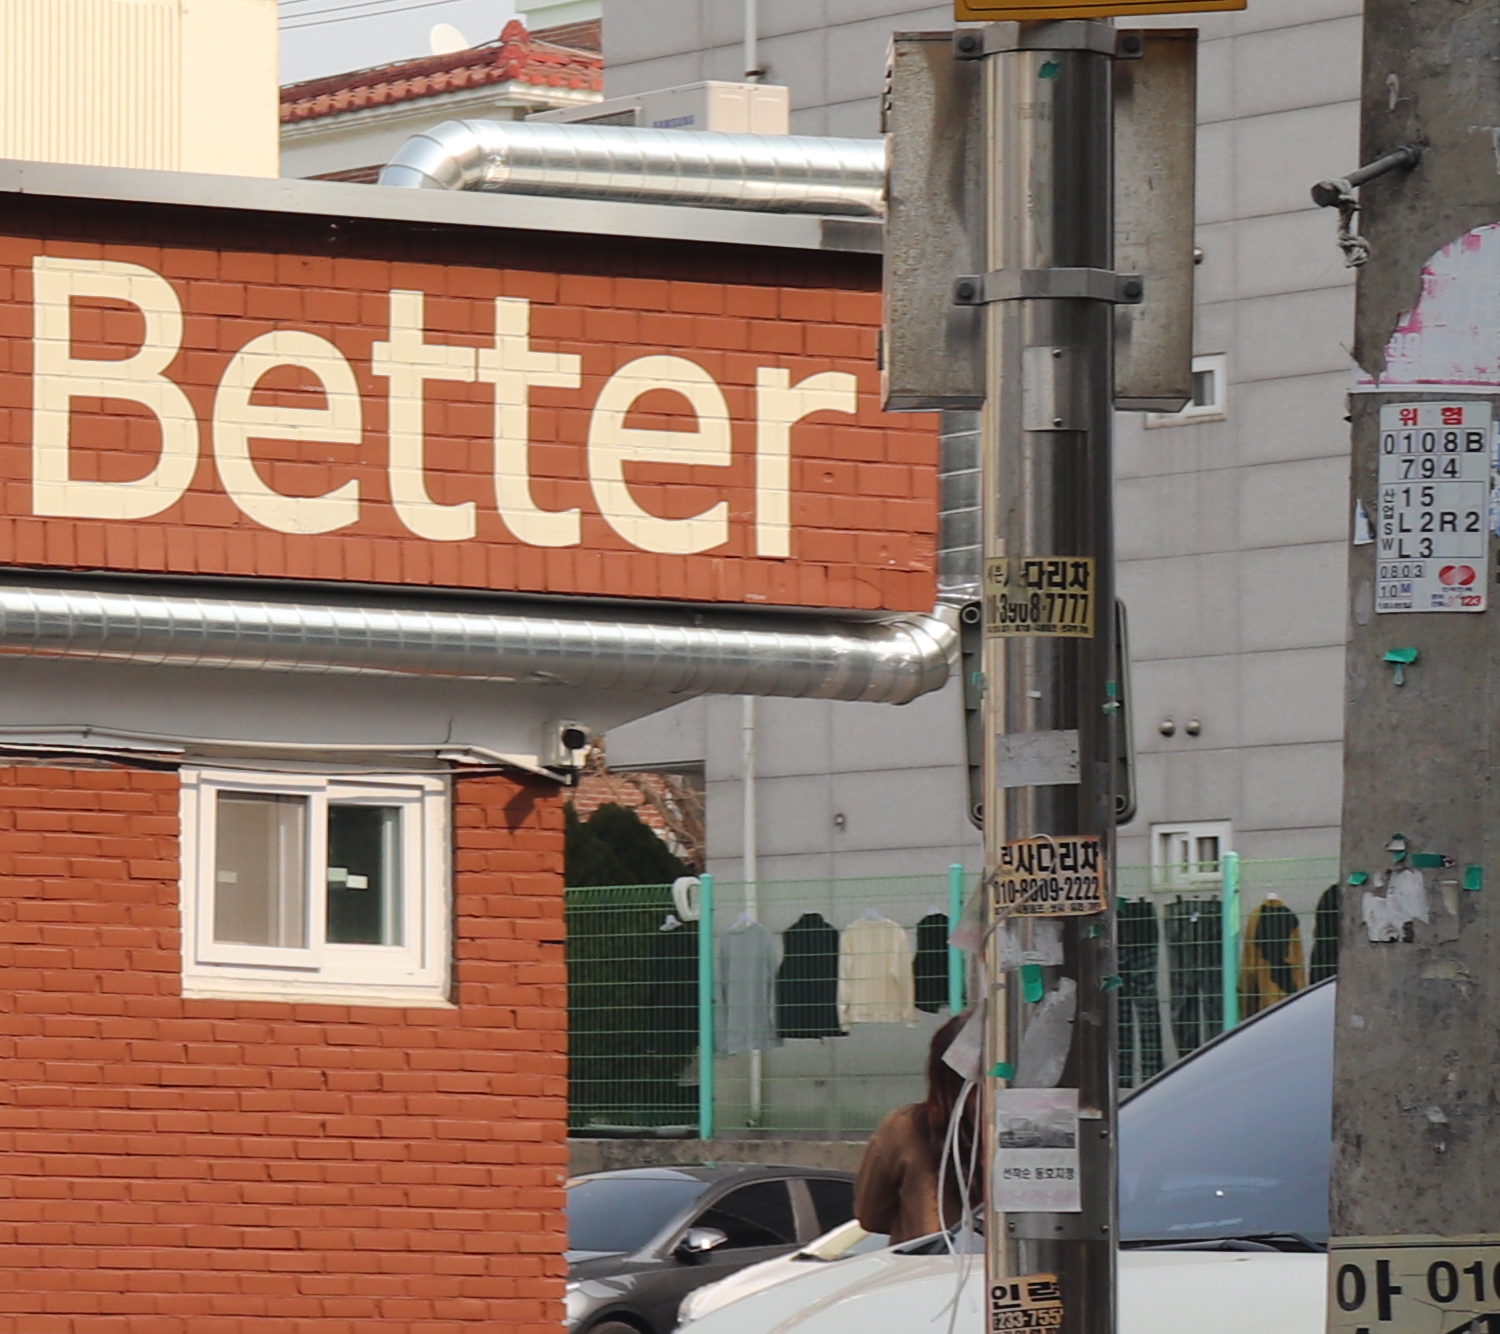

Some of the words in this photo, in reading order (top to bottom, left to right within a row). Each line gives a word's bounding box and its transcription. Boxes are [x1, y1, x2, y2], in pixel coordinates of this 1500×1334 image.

[31, 254, 856, 558] Better
[1399, 407, 1463, 426] 위험
[1384, 431, 1483, 454] 0108B
[1401, 458, 1458, 479] 794
[1402, 487, 1434, 507] 15
[1399, 511, 1480, 533] L2R2
[1398, 538, 1433, 558] L3
[1380, 565, 1423, 579] 0803
[1427, 1260, 1500, 1303] 01
[999, 1307, 1064, 1329] 233-755
